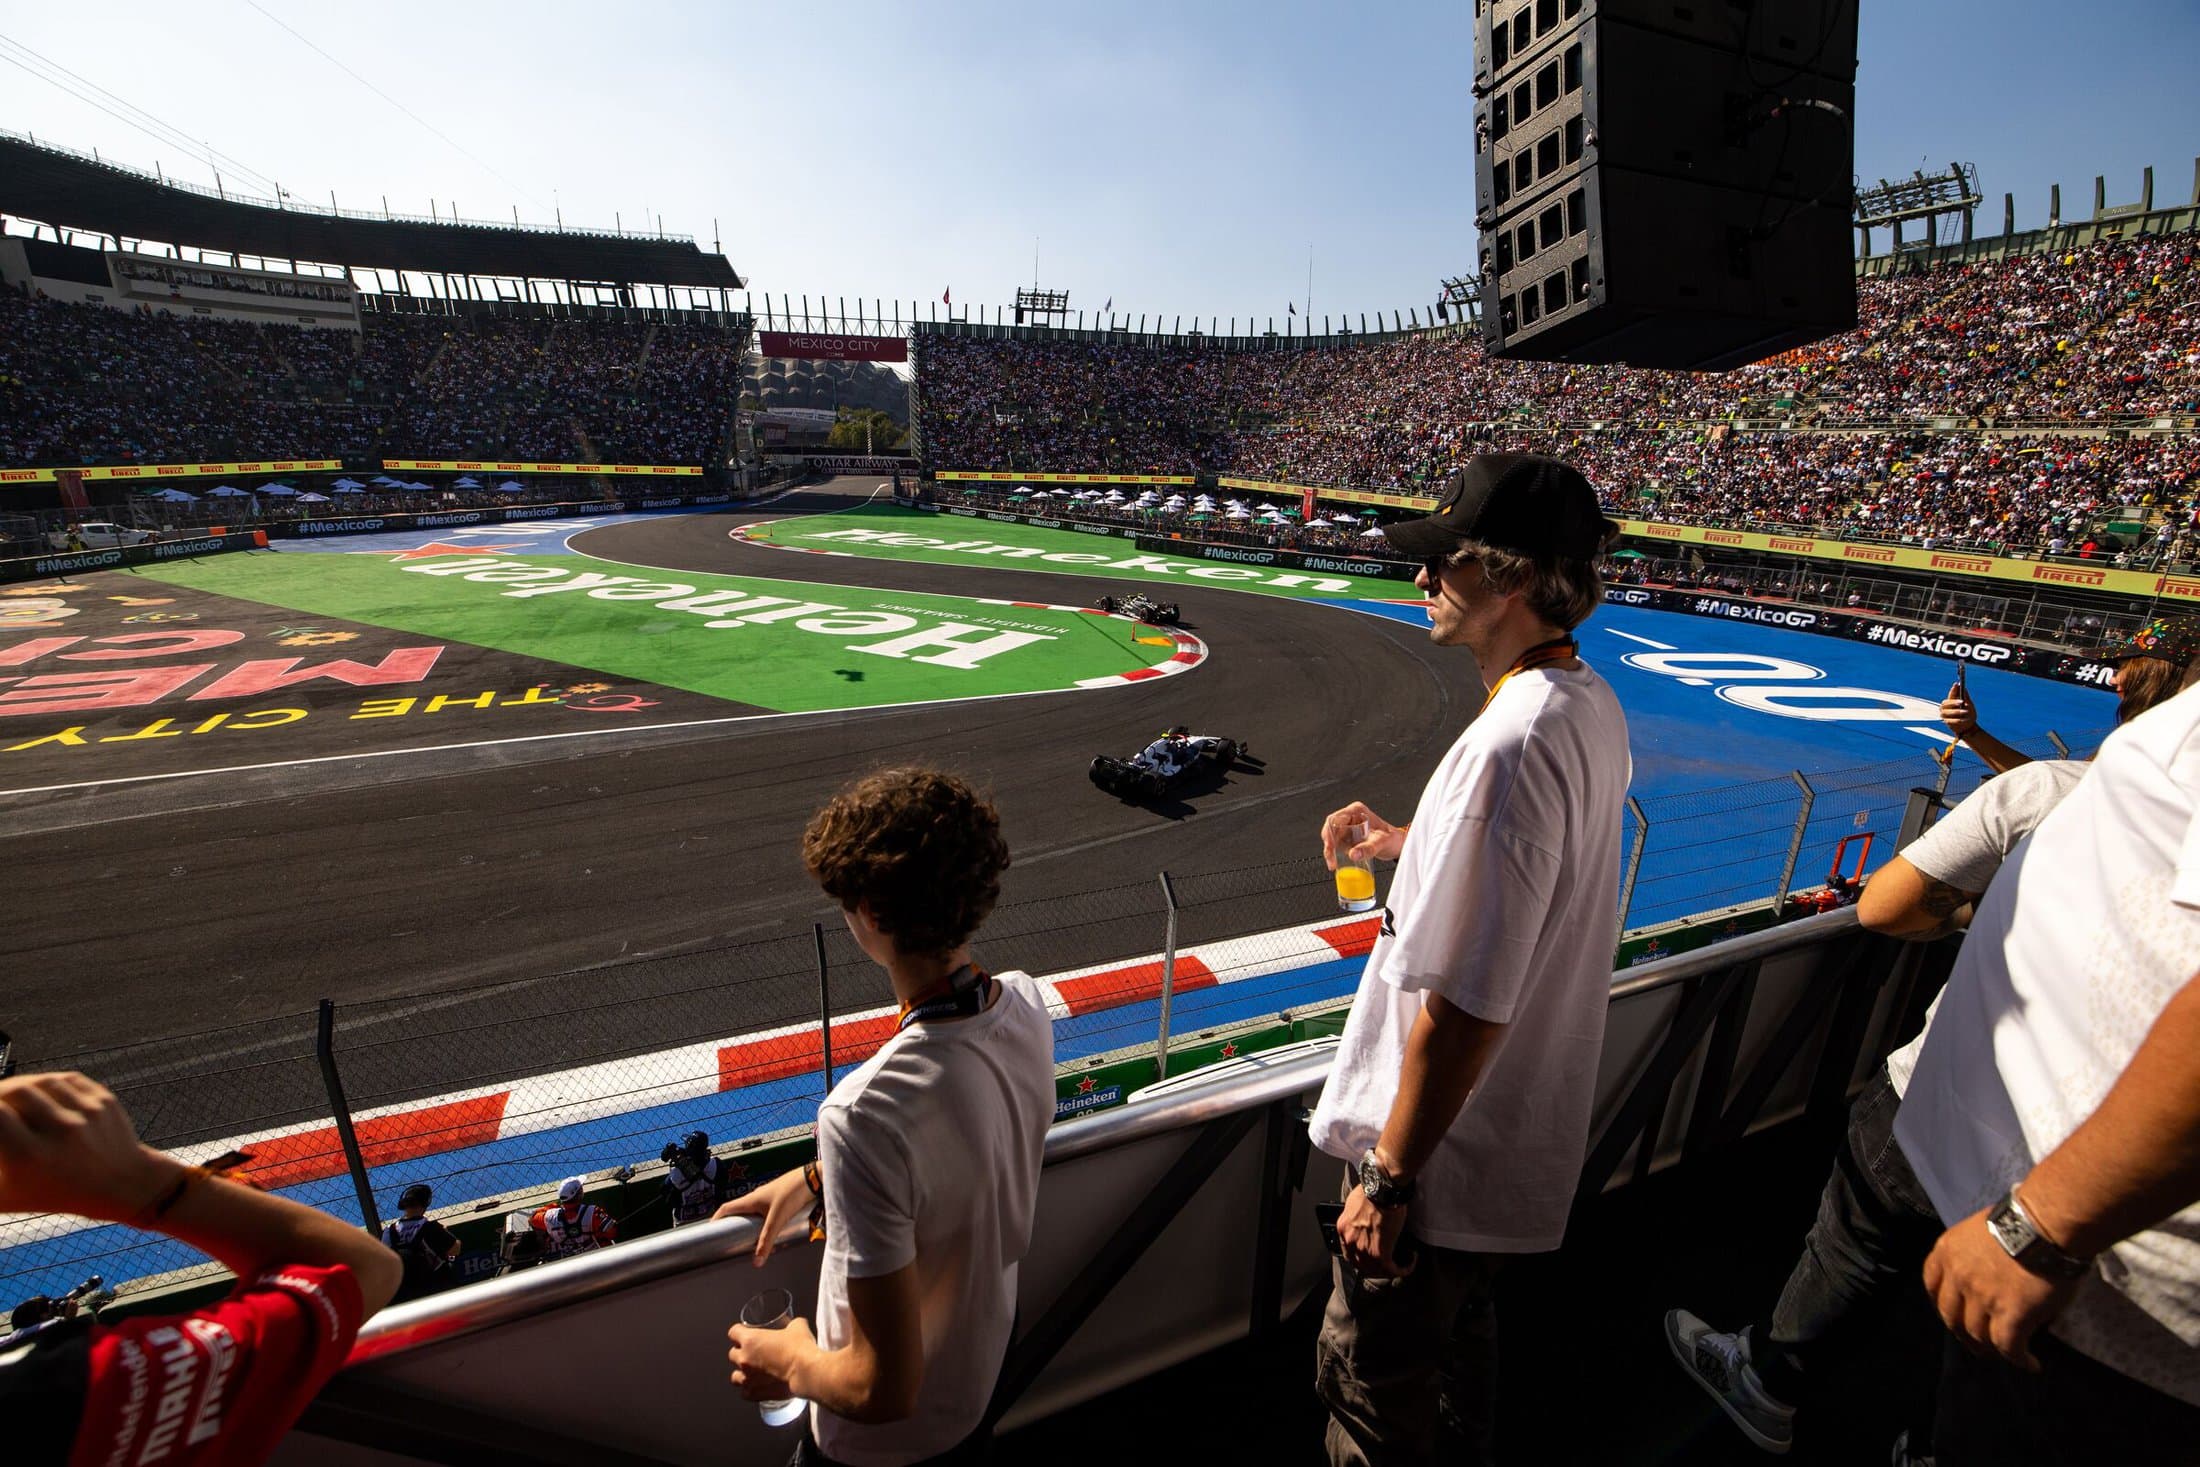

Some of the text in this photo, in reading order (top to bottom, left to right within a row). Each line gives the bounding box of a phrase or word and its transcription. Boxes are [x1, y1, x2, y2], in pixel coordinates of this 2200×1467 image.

[788, 338, 880, 351] MEXICO CITY
[200, 465, 224, 473] PIRELLI
[813, 458, 900, 468] QATAR AIRWAYS
[1, 471, 37, 480] PIRELLI
[111, 468, 140, 476] PIRELLI
[157, 467, 184, 475] PIRELLI
[505, 507, 559, 519] #MexicoGP
[580, 503, 625, 512] #MexicoGP
[299, 519, 384, 533] #MexicoGP
[417, 513, 480, 526] #MexicoGP
[1029, 517, 1060, 528] #MexicoGP
[1074, 524, 1109, 535] #MexicoGP
[1647, 524, 1681, 537] PIRELLI
[1704, 531, 1743, 544] PIRELLI
[155, 539, 223, 557] #MexicoGP
[1769, 538, 1814, 553] PIRELLI
[800, 528, 1352, 592] Heineken
[1204, 546, 1274, 563] #MexicoGP
[1844, 545, 1896, 562] PIRELLI
[36, 551, 121, 572] #MexicoGP
[1304, 557, 1382, 574] #MexicoGP
[1931, 554, 1992, 572] PIRELLI
[2033, 565, 2106, 585] PIRELLI
[2155, 578, 2200, 597] PIRE
[402, 558, 1058, 670] Heineken
[1695, 598, 1816, 627] #MexicoGP
[1867, 624, 2011, 663] #MexicoGP
[1, 687, 560, 752] THE CITY
[1055, 1091, 1117, 1114] Heineken
